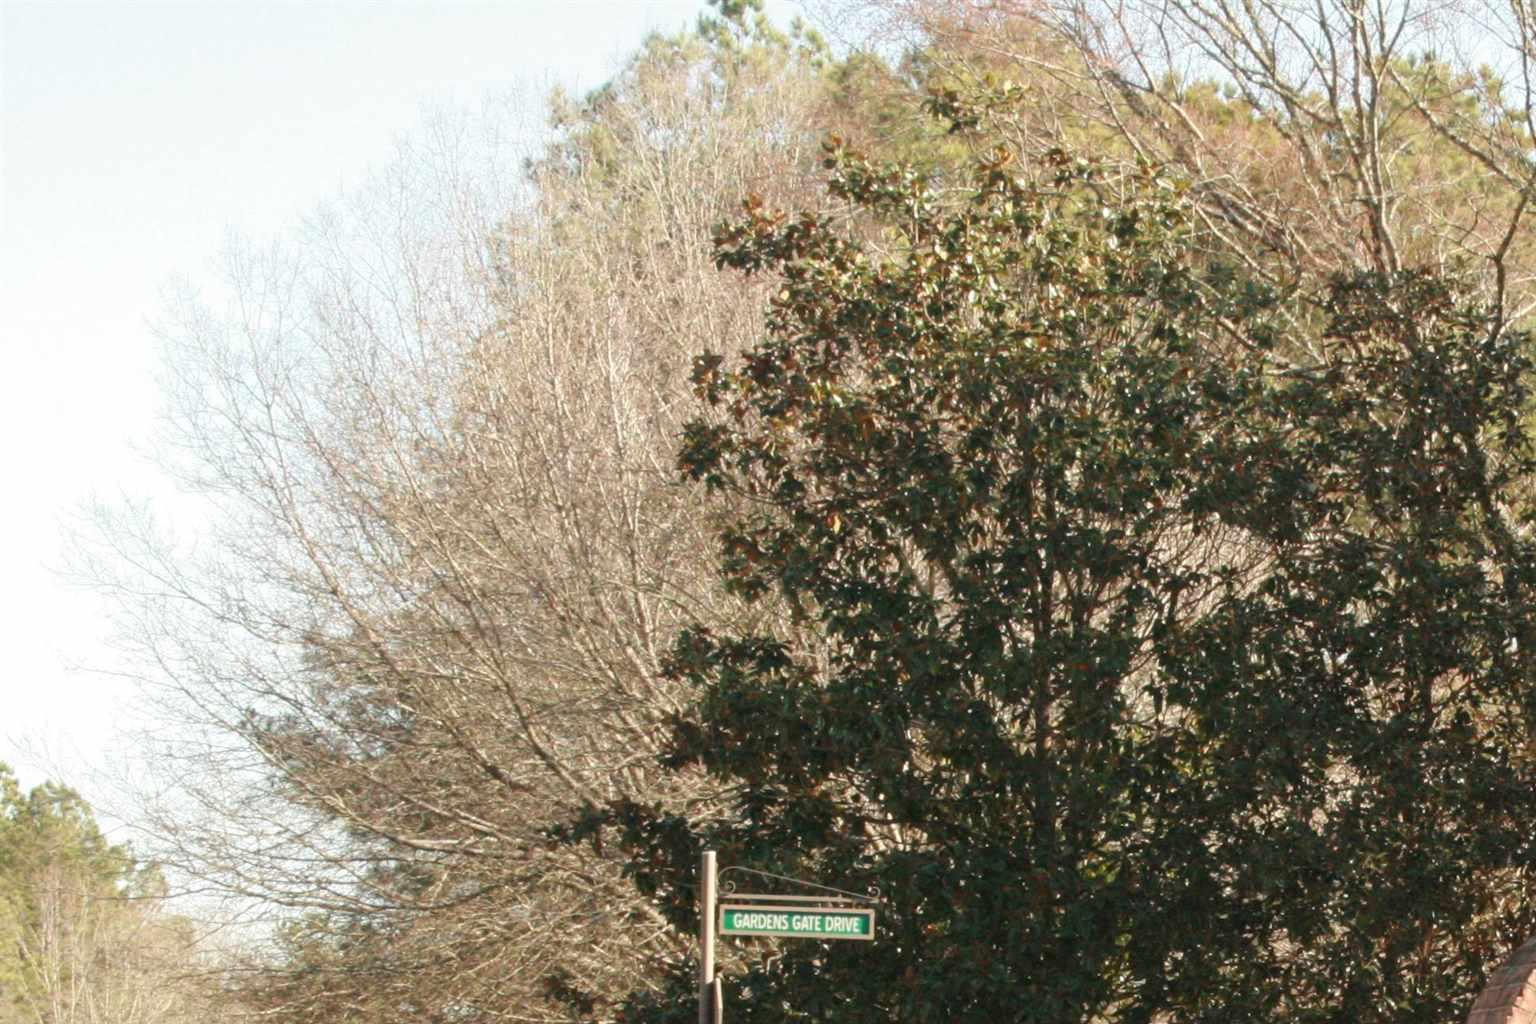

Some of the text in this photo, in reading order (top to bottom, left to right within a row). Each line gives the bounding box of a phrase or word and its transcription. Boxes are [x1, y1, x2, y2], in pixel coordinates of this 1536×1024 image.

[733, 912, 861, 933] GARDENS GATE DRIVE
